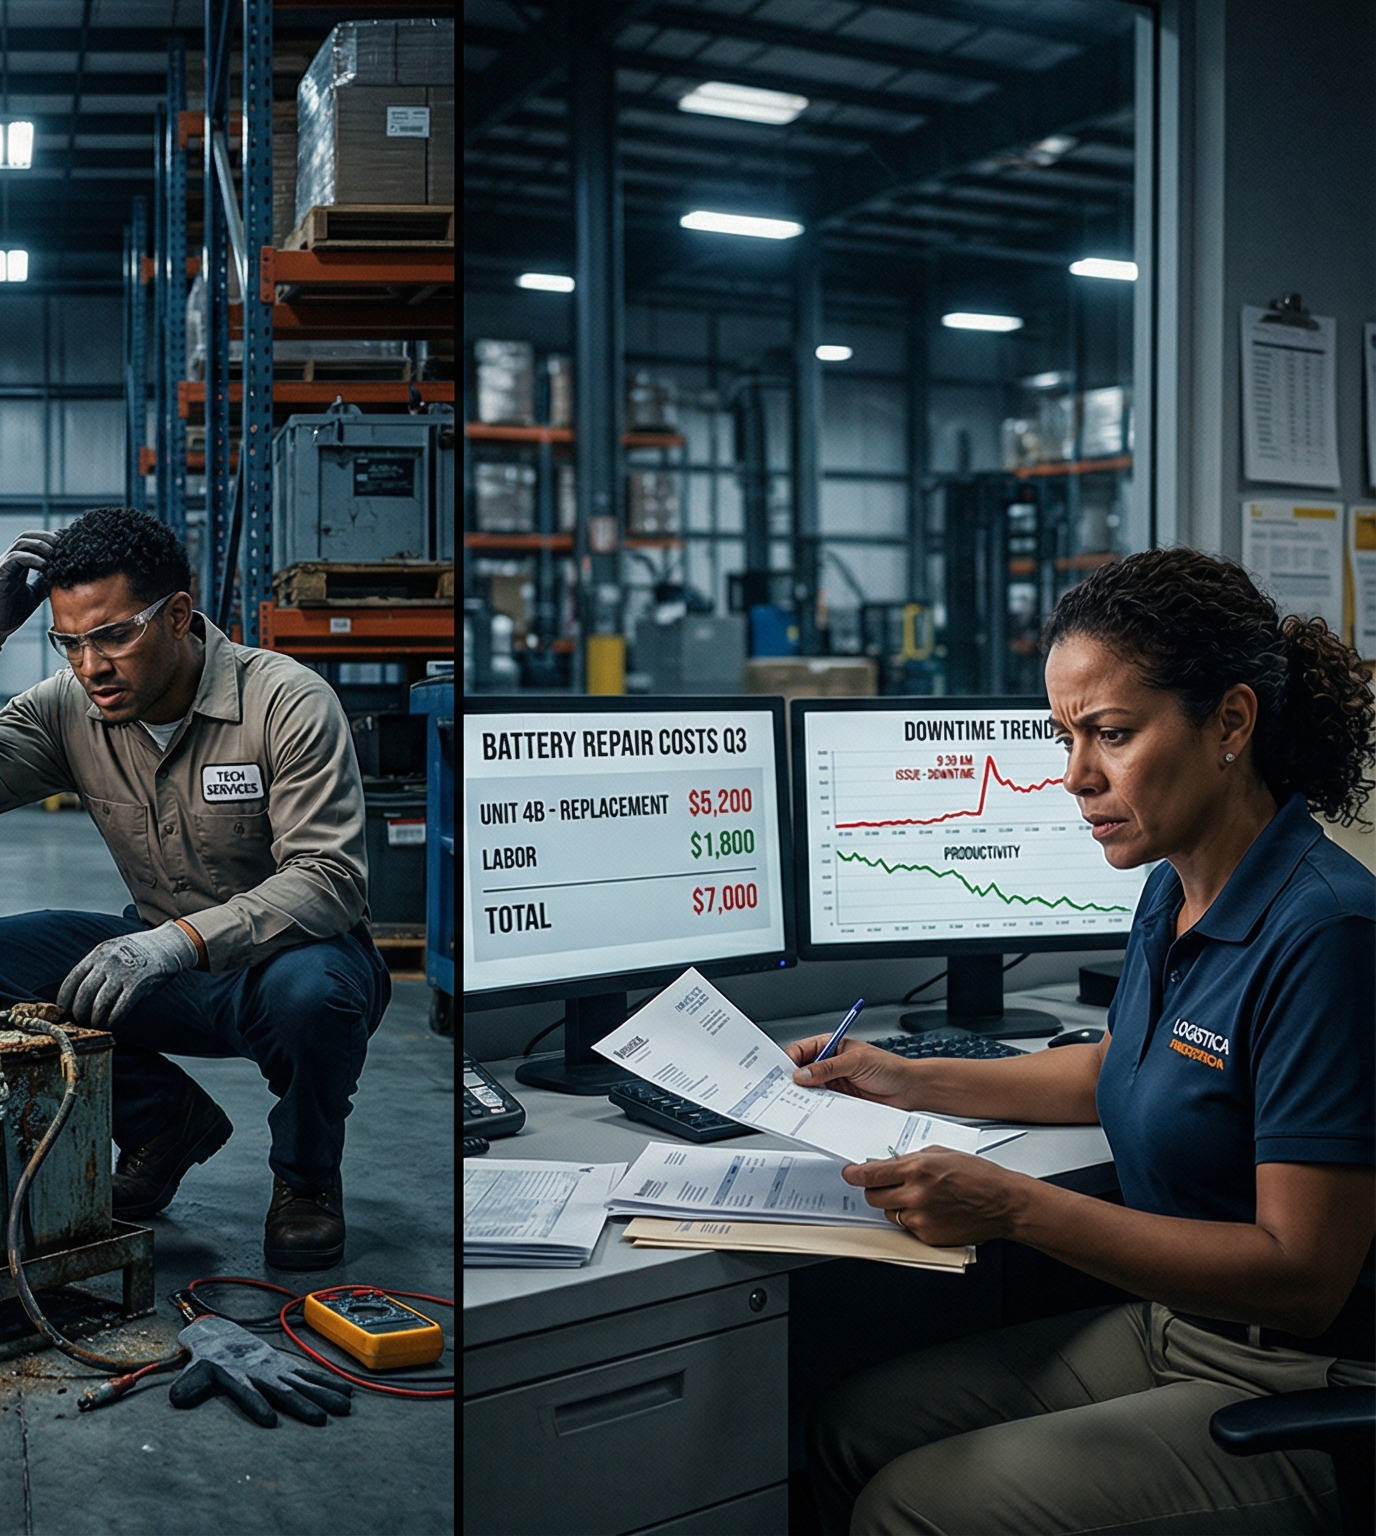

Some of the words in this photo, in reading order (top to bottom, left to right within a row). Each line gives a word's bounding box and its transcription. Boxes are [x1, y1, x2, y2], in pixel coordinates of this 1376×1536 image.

[482, 731, 576, 760] BATTERY
[582, 729, 654, 758] REPAIR
[658, 728, 718, 756] COSTS
[723, 727, 747, 755] Q3
[905, 720, 996, 741] DOWNTIME
[480, 802, 518, 824] UNIT
[523, 800, 545, 822] 4B
[560, 794, 669, 821] REPLACEMENT
[688, 787, 752, 818] $5,200
[482, 845, 537, 870] LABOR
[690, 828, 755, 860] $1,800
[484, 902, 552, 934] TOTAL
[692, 883, 758, 916] $7,000
